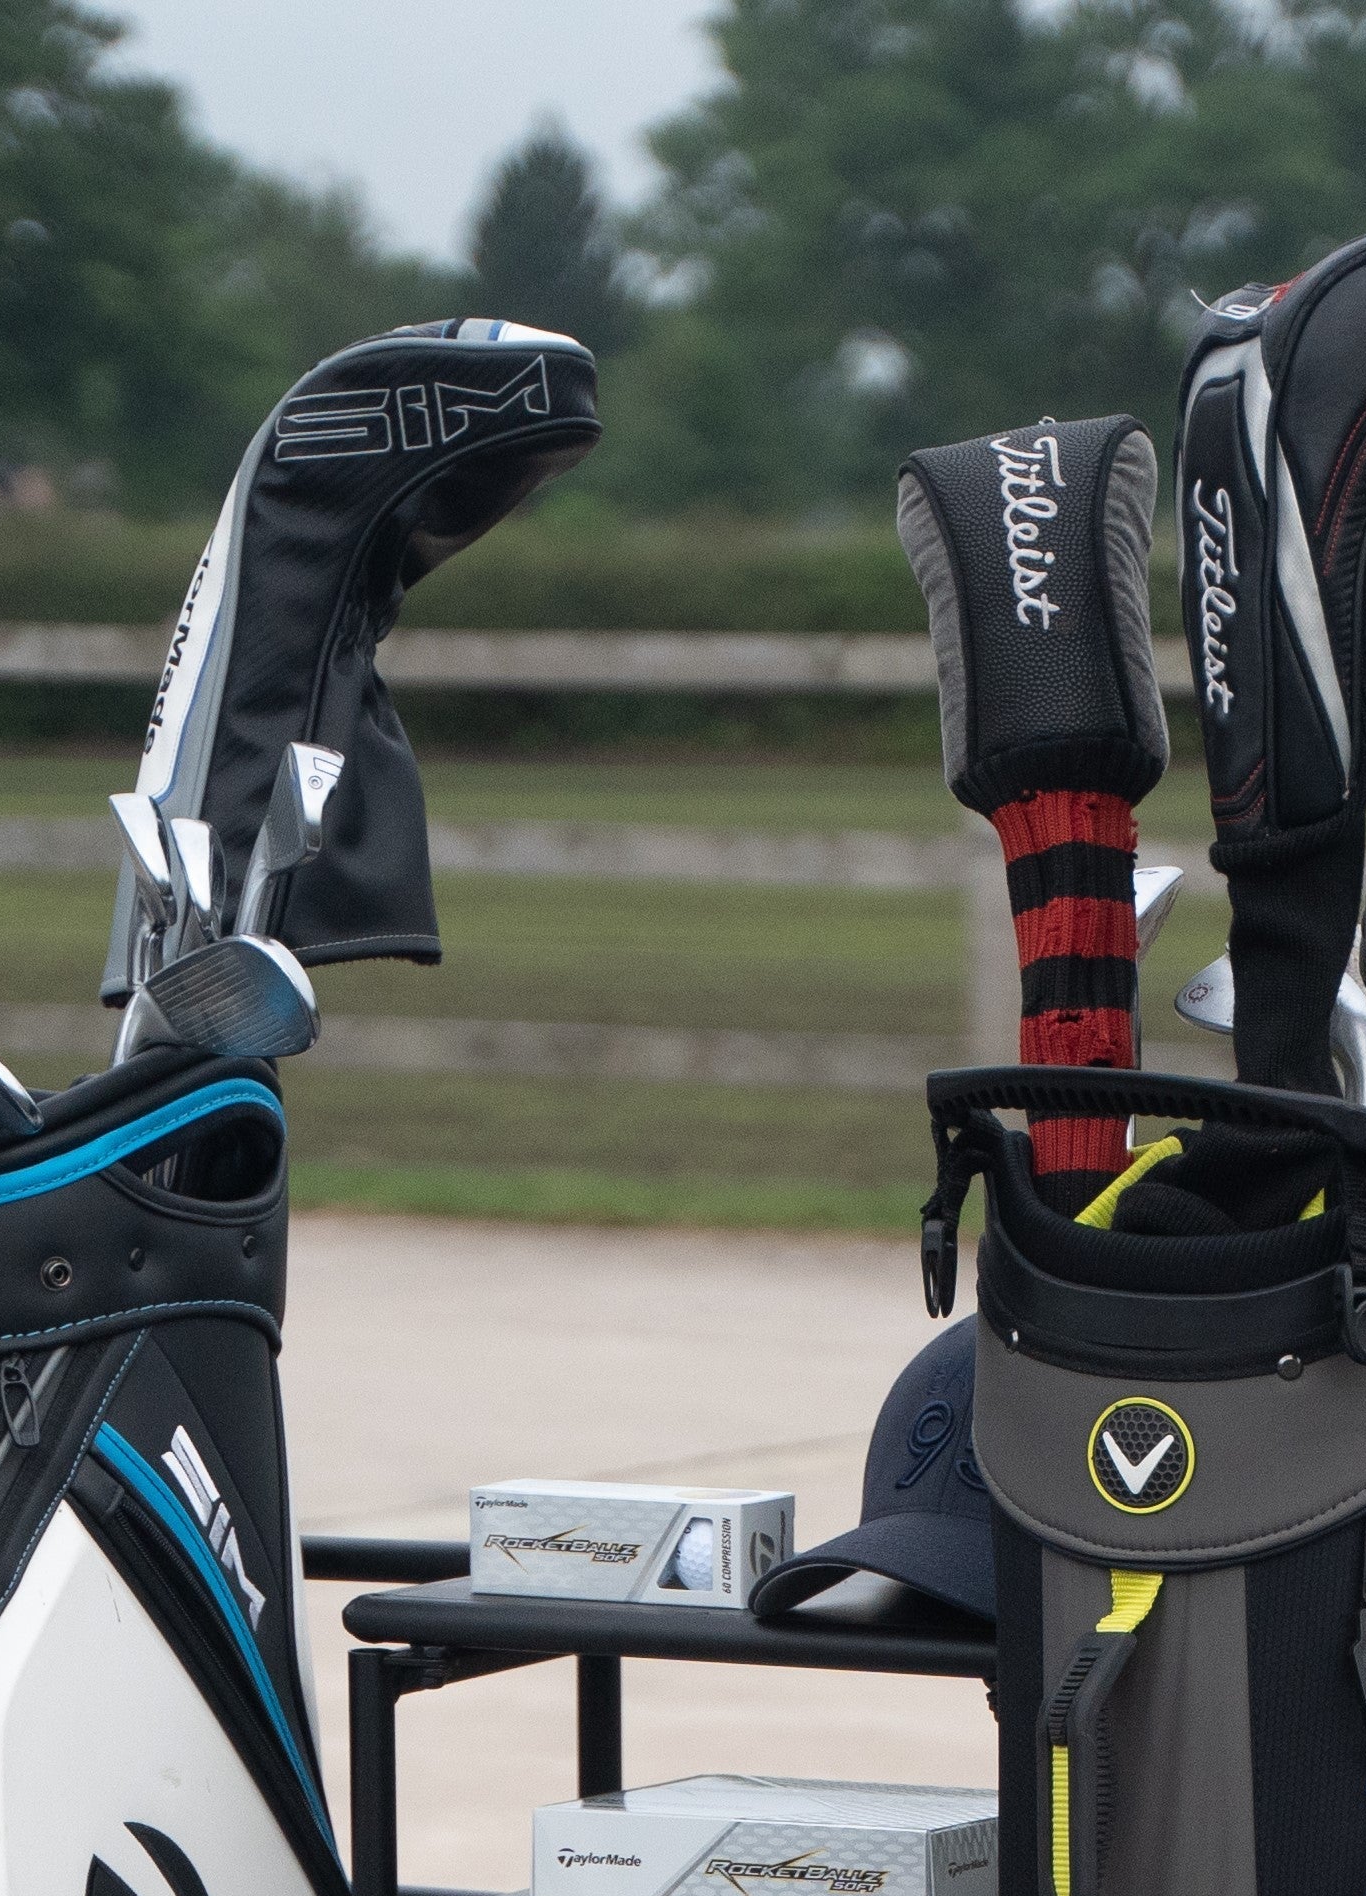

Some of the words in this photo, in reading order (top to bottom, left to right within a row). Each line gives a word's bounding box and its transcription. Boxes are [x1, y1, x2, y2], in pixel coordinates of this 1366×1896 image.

[989, 435, 1067, 631] Titleist
[1193, 479, 1239, 716] Titleist
[594, 1553, 635, 1563] SOFT
[557, 1848, 642, 1868] TaylorMade
[832, 1879, 880, 1893] SOFT
